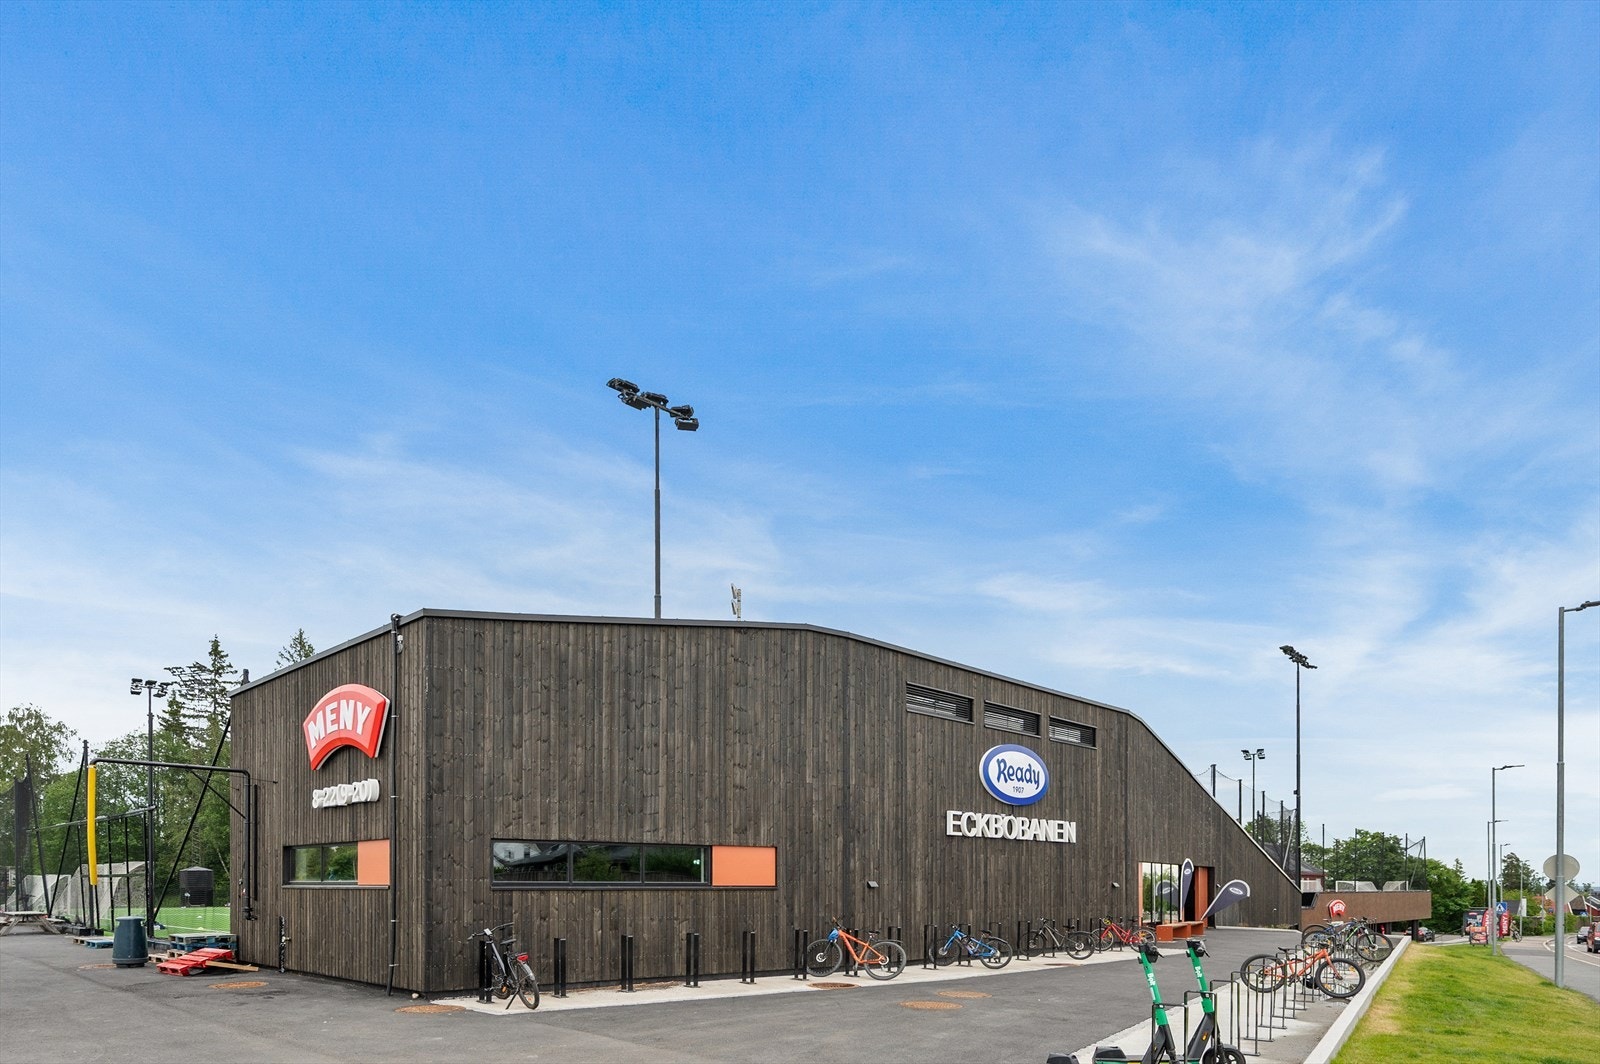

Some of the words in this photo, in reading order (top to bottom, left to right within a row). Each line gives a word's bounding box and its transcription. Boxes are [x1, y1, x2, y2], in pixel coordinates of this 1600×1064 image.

[307, 699, 372, 749] MENY
[996, 758, 1040, 790] Ready
[1012, 786, 1024, 794] 1907
[946, 810, 1076, 843] ECKBOBANEN
